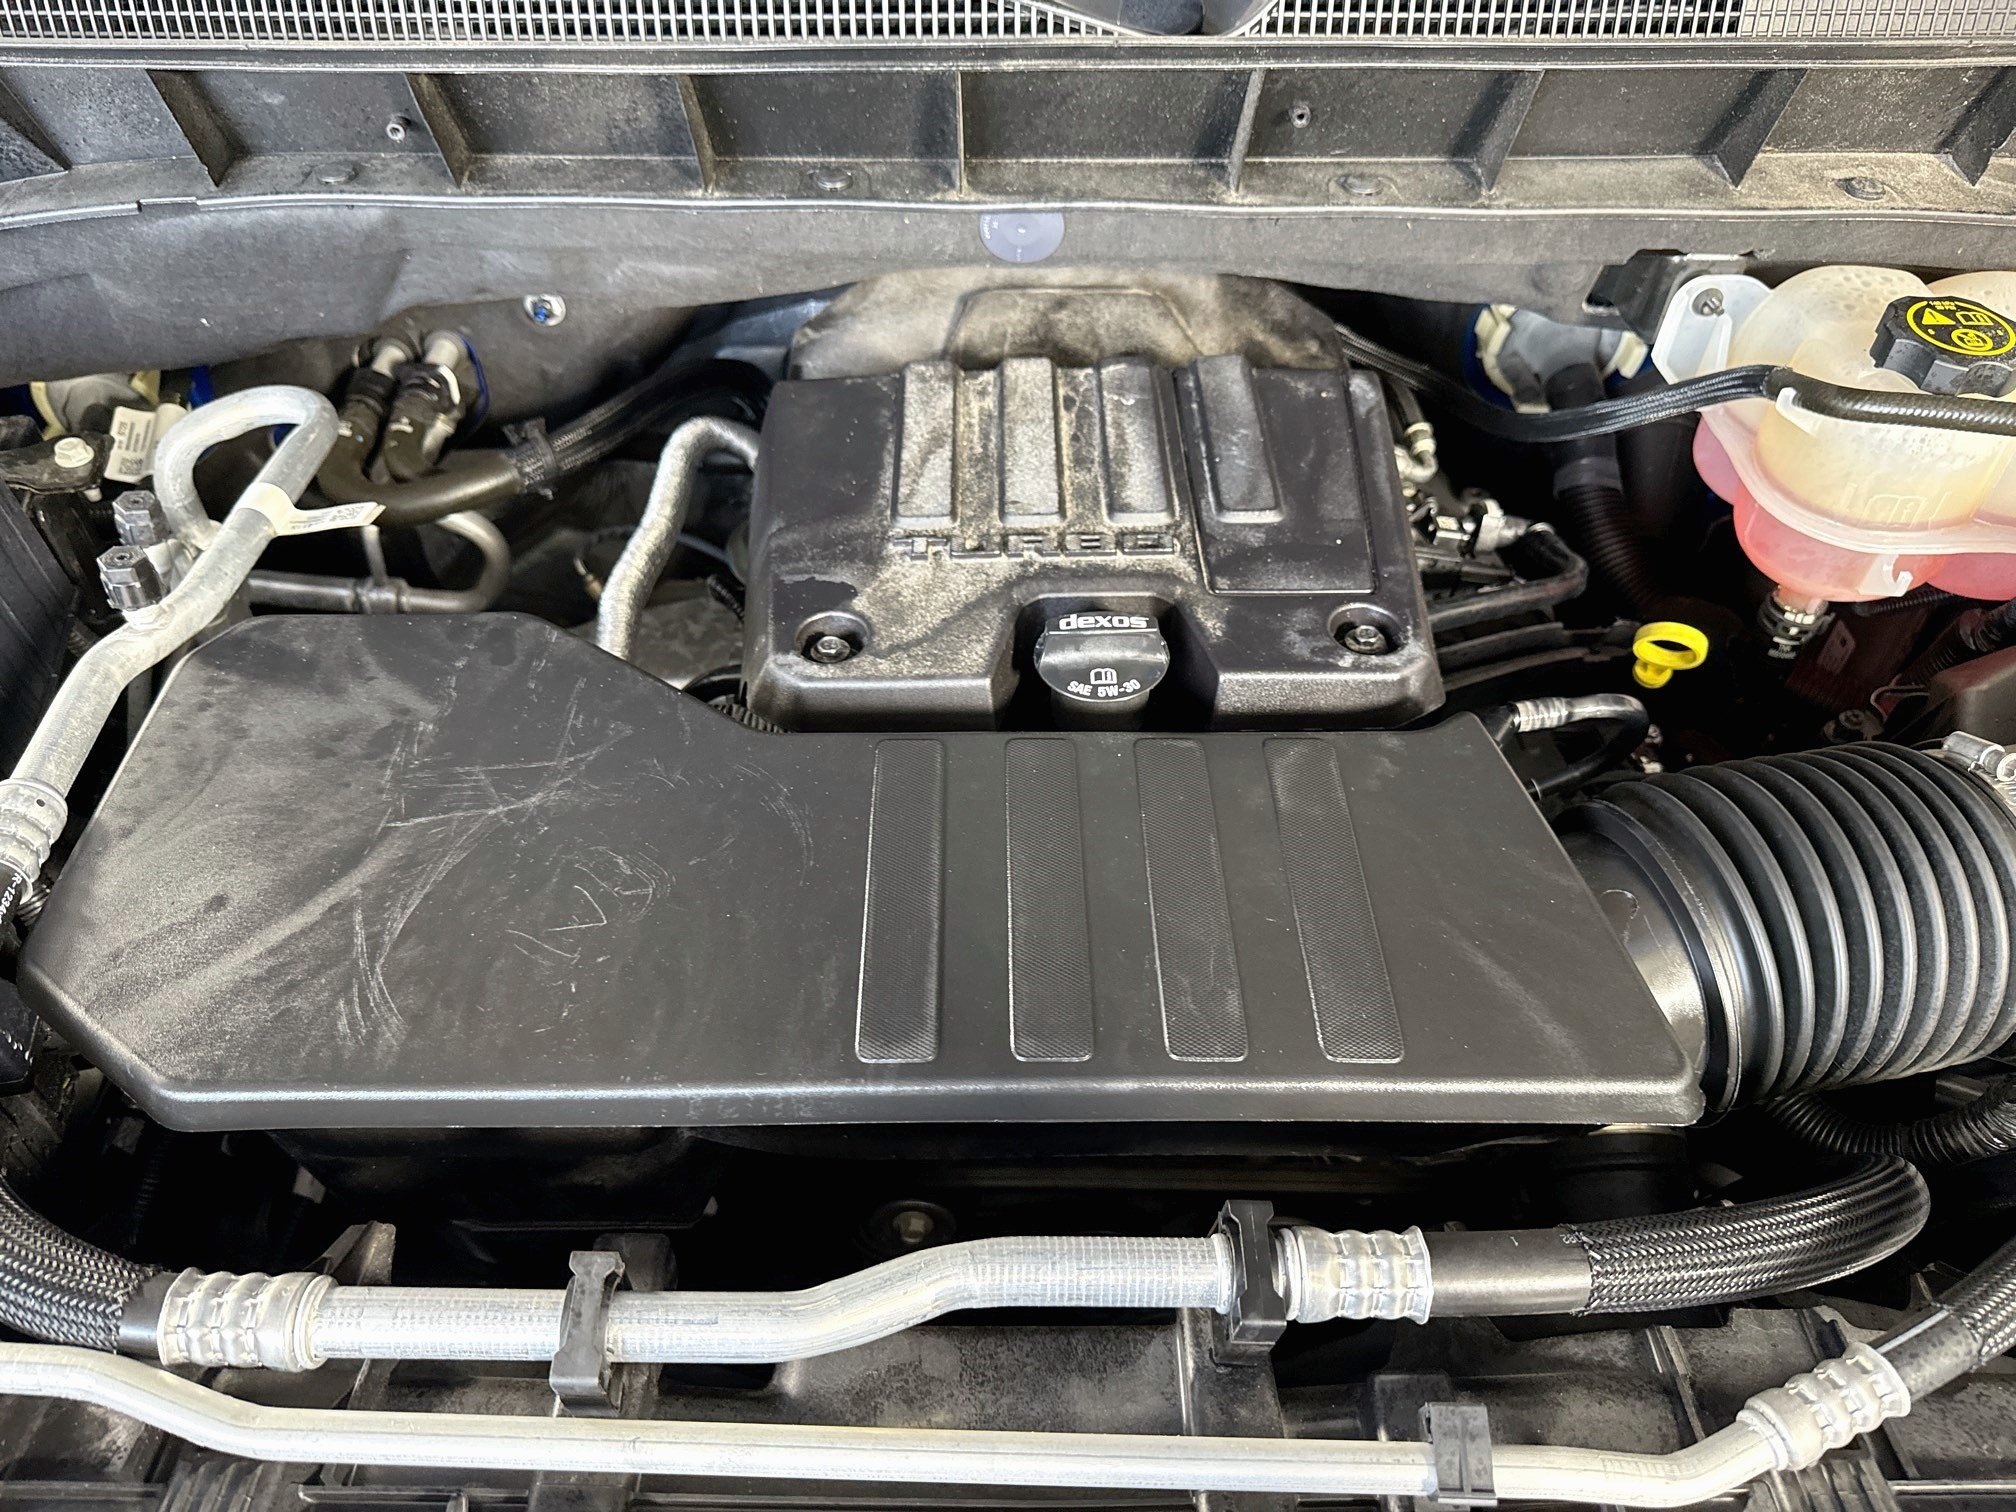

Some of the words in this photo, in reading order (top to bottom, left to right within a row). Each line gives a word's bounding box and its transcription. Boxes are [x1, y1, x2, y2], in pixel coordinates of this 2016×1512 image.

[1058, 613, 1149, 630] dexos
[1067, 680, 1092, 697] SAE
[1097, 678, 1141, 698] 5W-30
